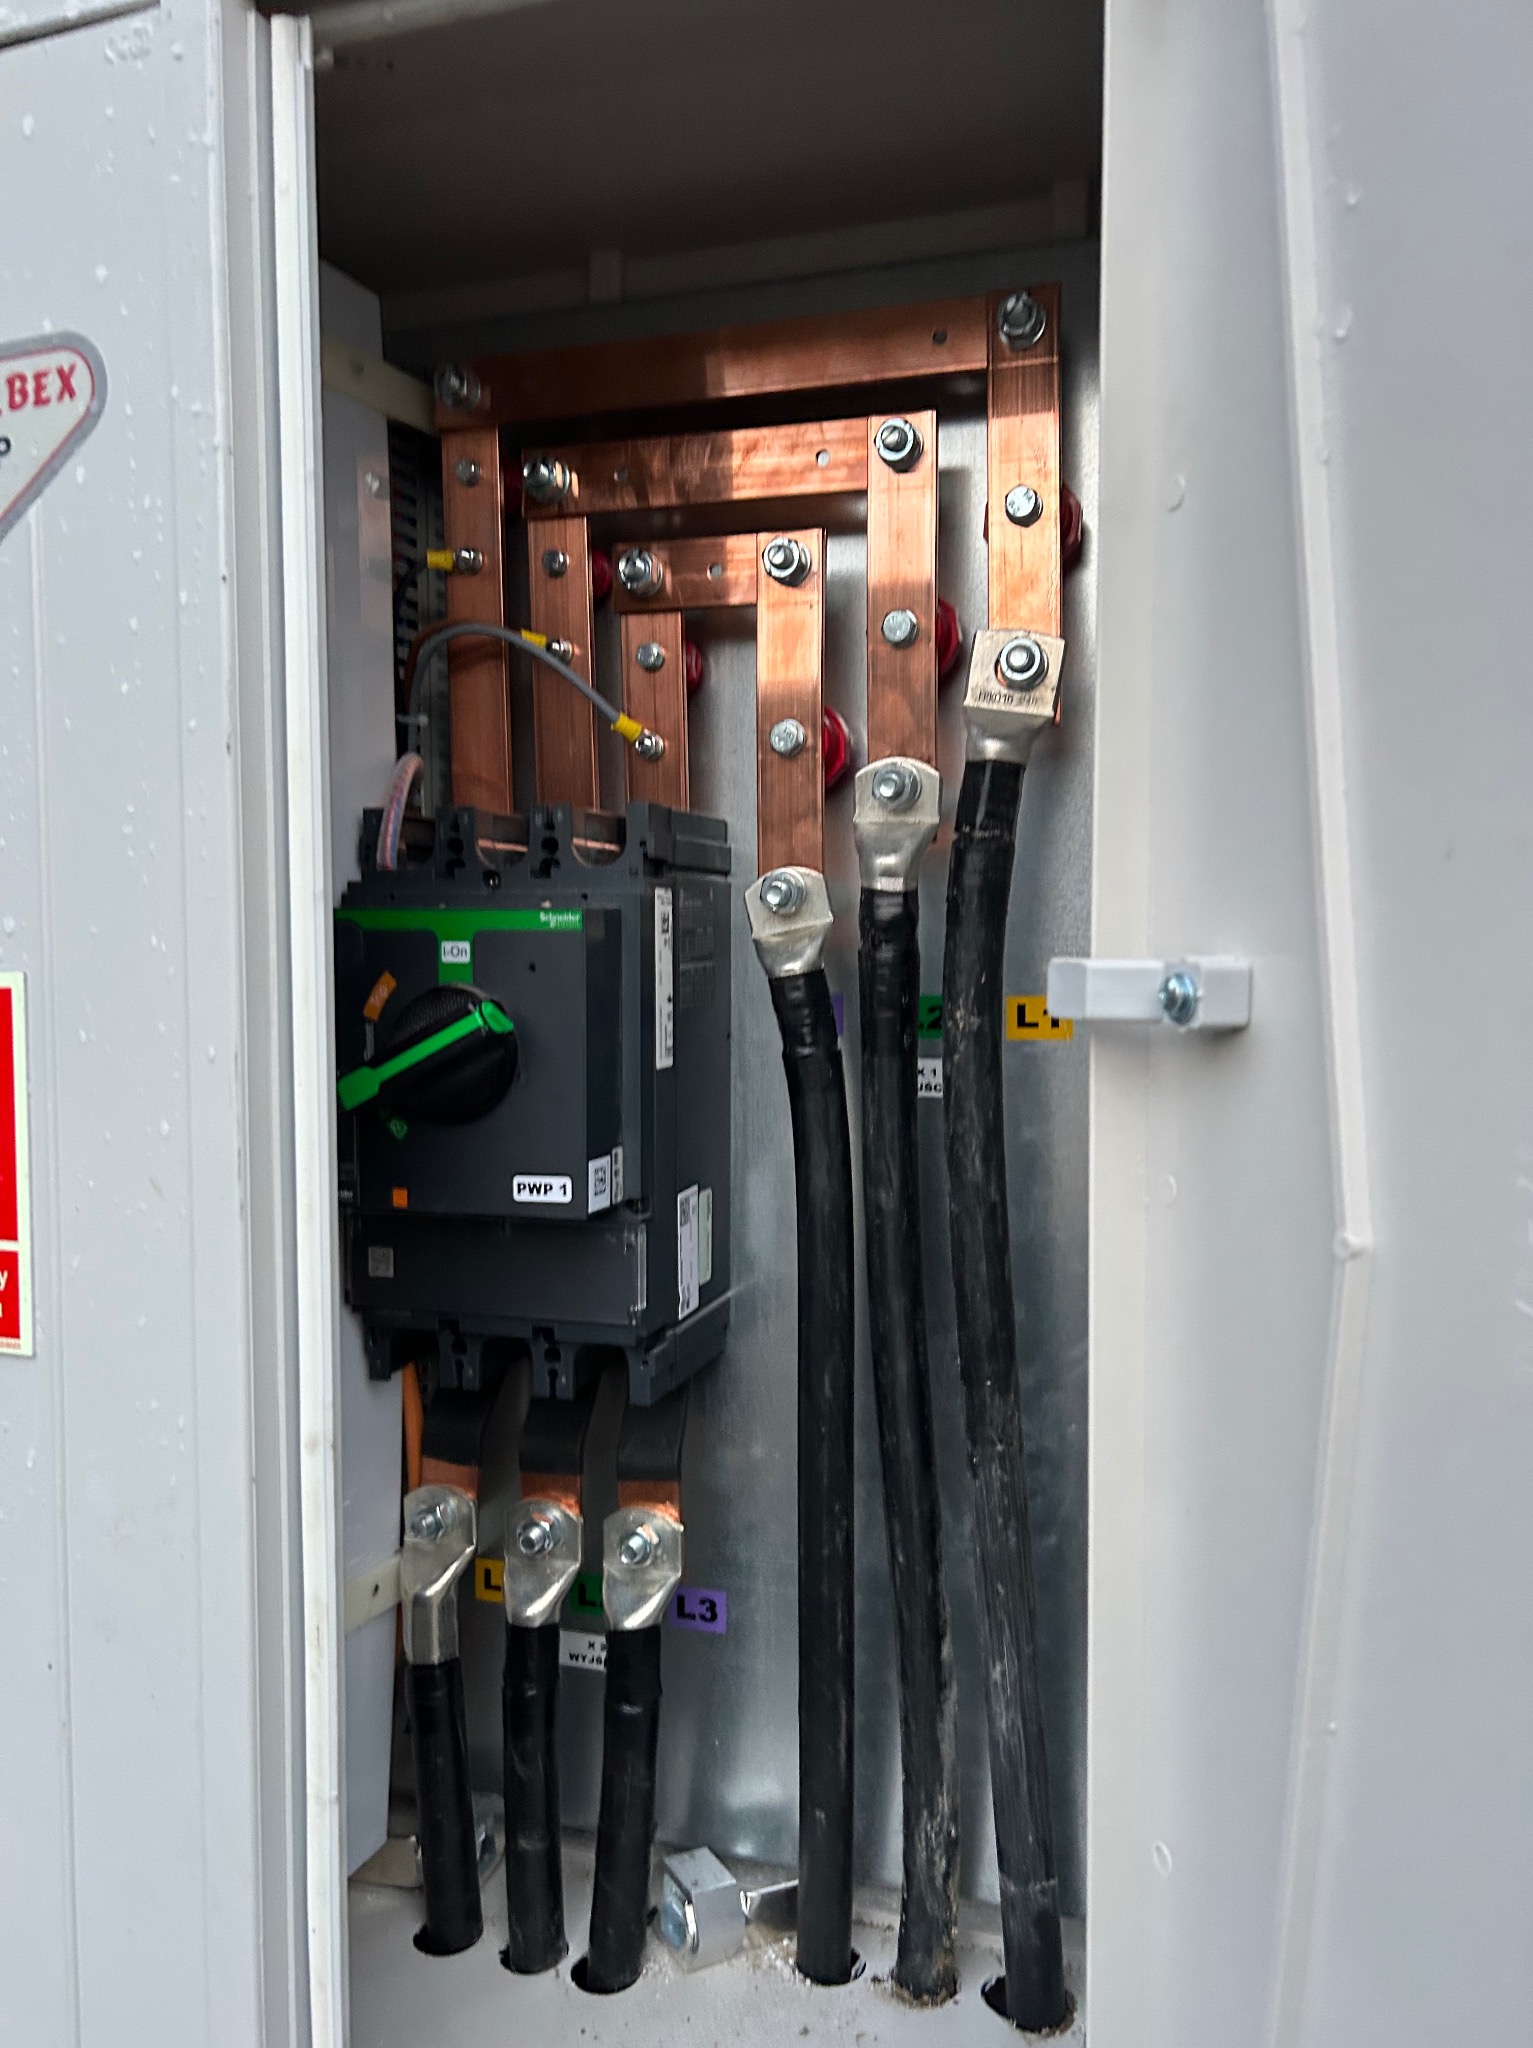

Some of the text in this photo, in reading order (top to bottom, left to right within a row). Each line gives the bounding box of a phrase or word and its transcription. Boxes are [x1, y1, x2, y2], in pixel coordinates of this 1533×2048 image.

[0, 363, 77, 414] BEX
[919, 1005, 942, 1030] 2
[517, 1182, 567, 1196] PWP 1
[484, 1568, 502, 1592] L
[577, 1583, 604, 1608] L
[676, 1594, 719, 1624] L3
